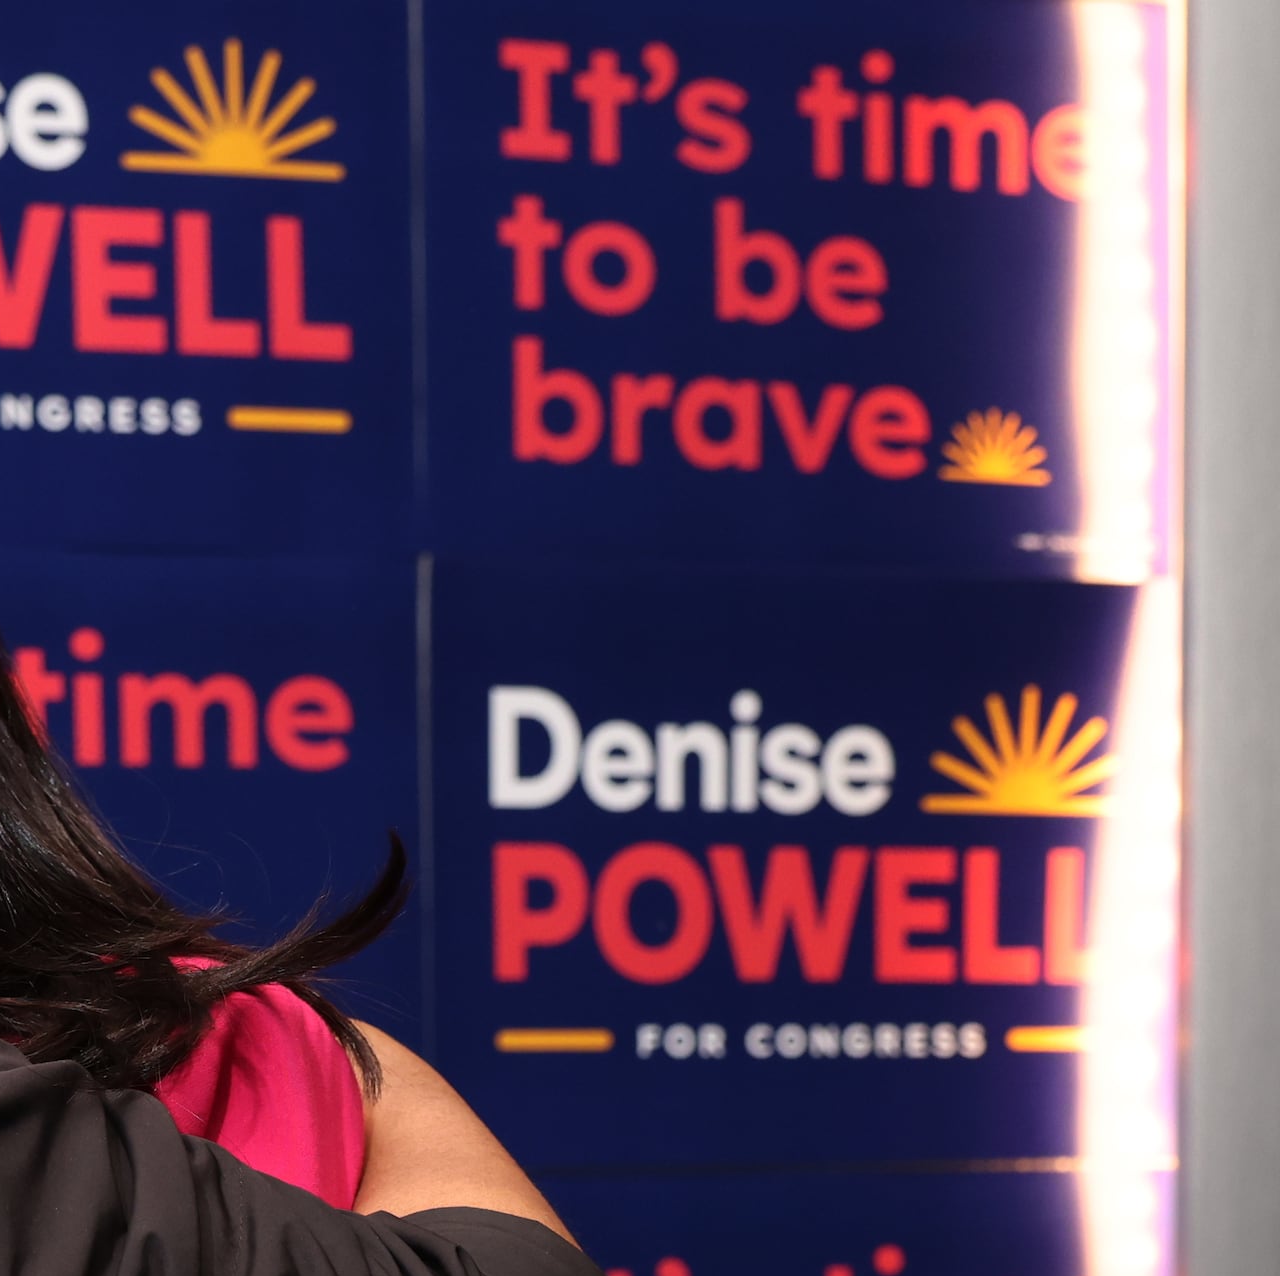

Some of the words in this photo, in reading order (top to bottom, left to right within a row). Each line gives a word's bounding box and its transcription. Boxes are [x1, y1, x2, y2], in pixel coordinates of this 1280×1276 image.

[497, 195, 656, 315] to
[714, 198, 888, 329] be
[512, 336, 932, 480] brave
[487, 685, 896, 817] Denise
[635, 1023, 727, 1060] FOR
[744, 1022, 988, 1060] CONGRESS
